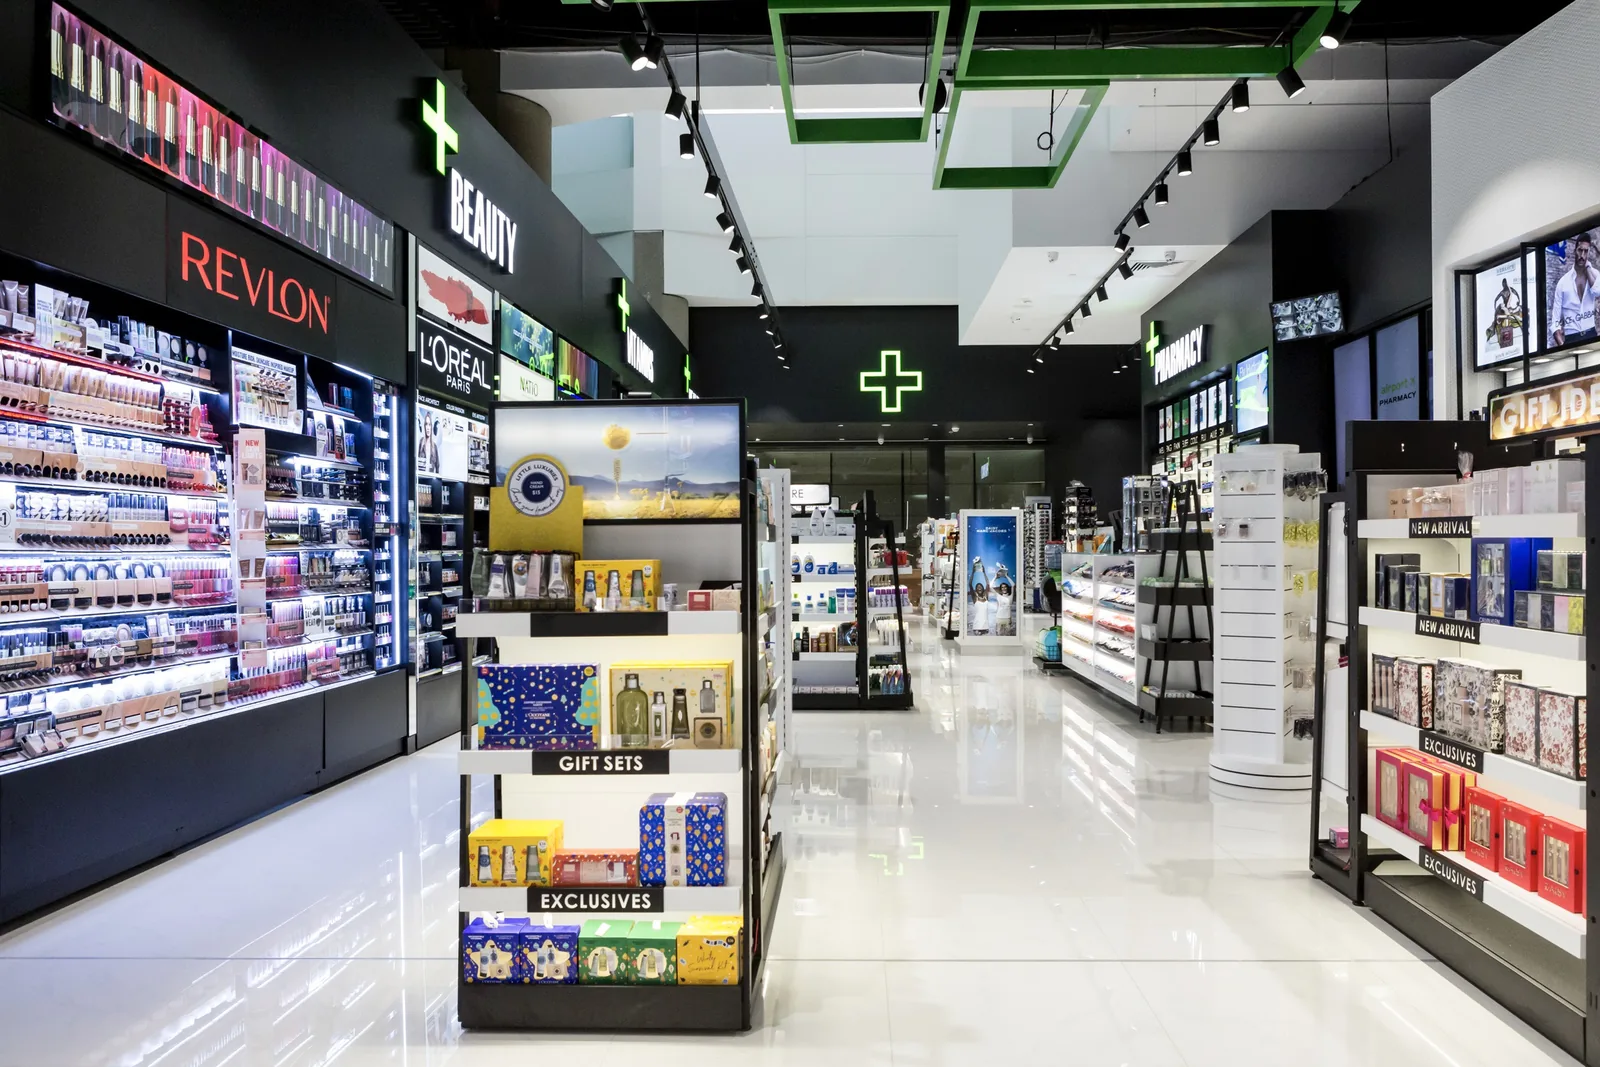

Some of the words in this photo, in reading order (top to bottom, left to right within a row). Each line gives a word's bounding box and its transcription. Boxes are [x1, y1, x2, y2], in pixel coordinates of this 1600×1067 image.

[451, 167, 517, 275] BEAUTY
[181, 231, 329, 335] REVLON
[420, 332, 491, 390] L'ORÉAL
[1155, 325, 1203, 386] PHARMACY
[520, 376, 539, 397] NATIO
[1379, 391, 1417, 406] PHARMACY
[1501, 394, 1550, 432] GIFT
[515, 465, 532, 481] LITTLE
[533, 464, 559, 482] LUXURIES
[1411, 522, 1429, 535] NEW
[1431, 520, 1470, 535] ARRIVAL
[1419, 620, 1437, 633] NEW
[1438, 623, 1476, 640] ARRIVAL
[559, 756, 599, 771] GIFT
[603, 755, 643, 771] SETS
[1424, 737, 1477, 768] EXCLUSIVES
[1424, 854, 1477, 895] EXCLUSIVES
[541, 893, 651, 909] EXCLUSIVES
